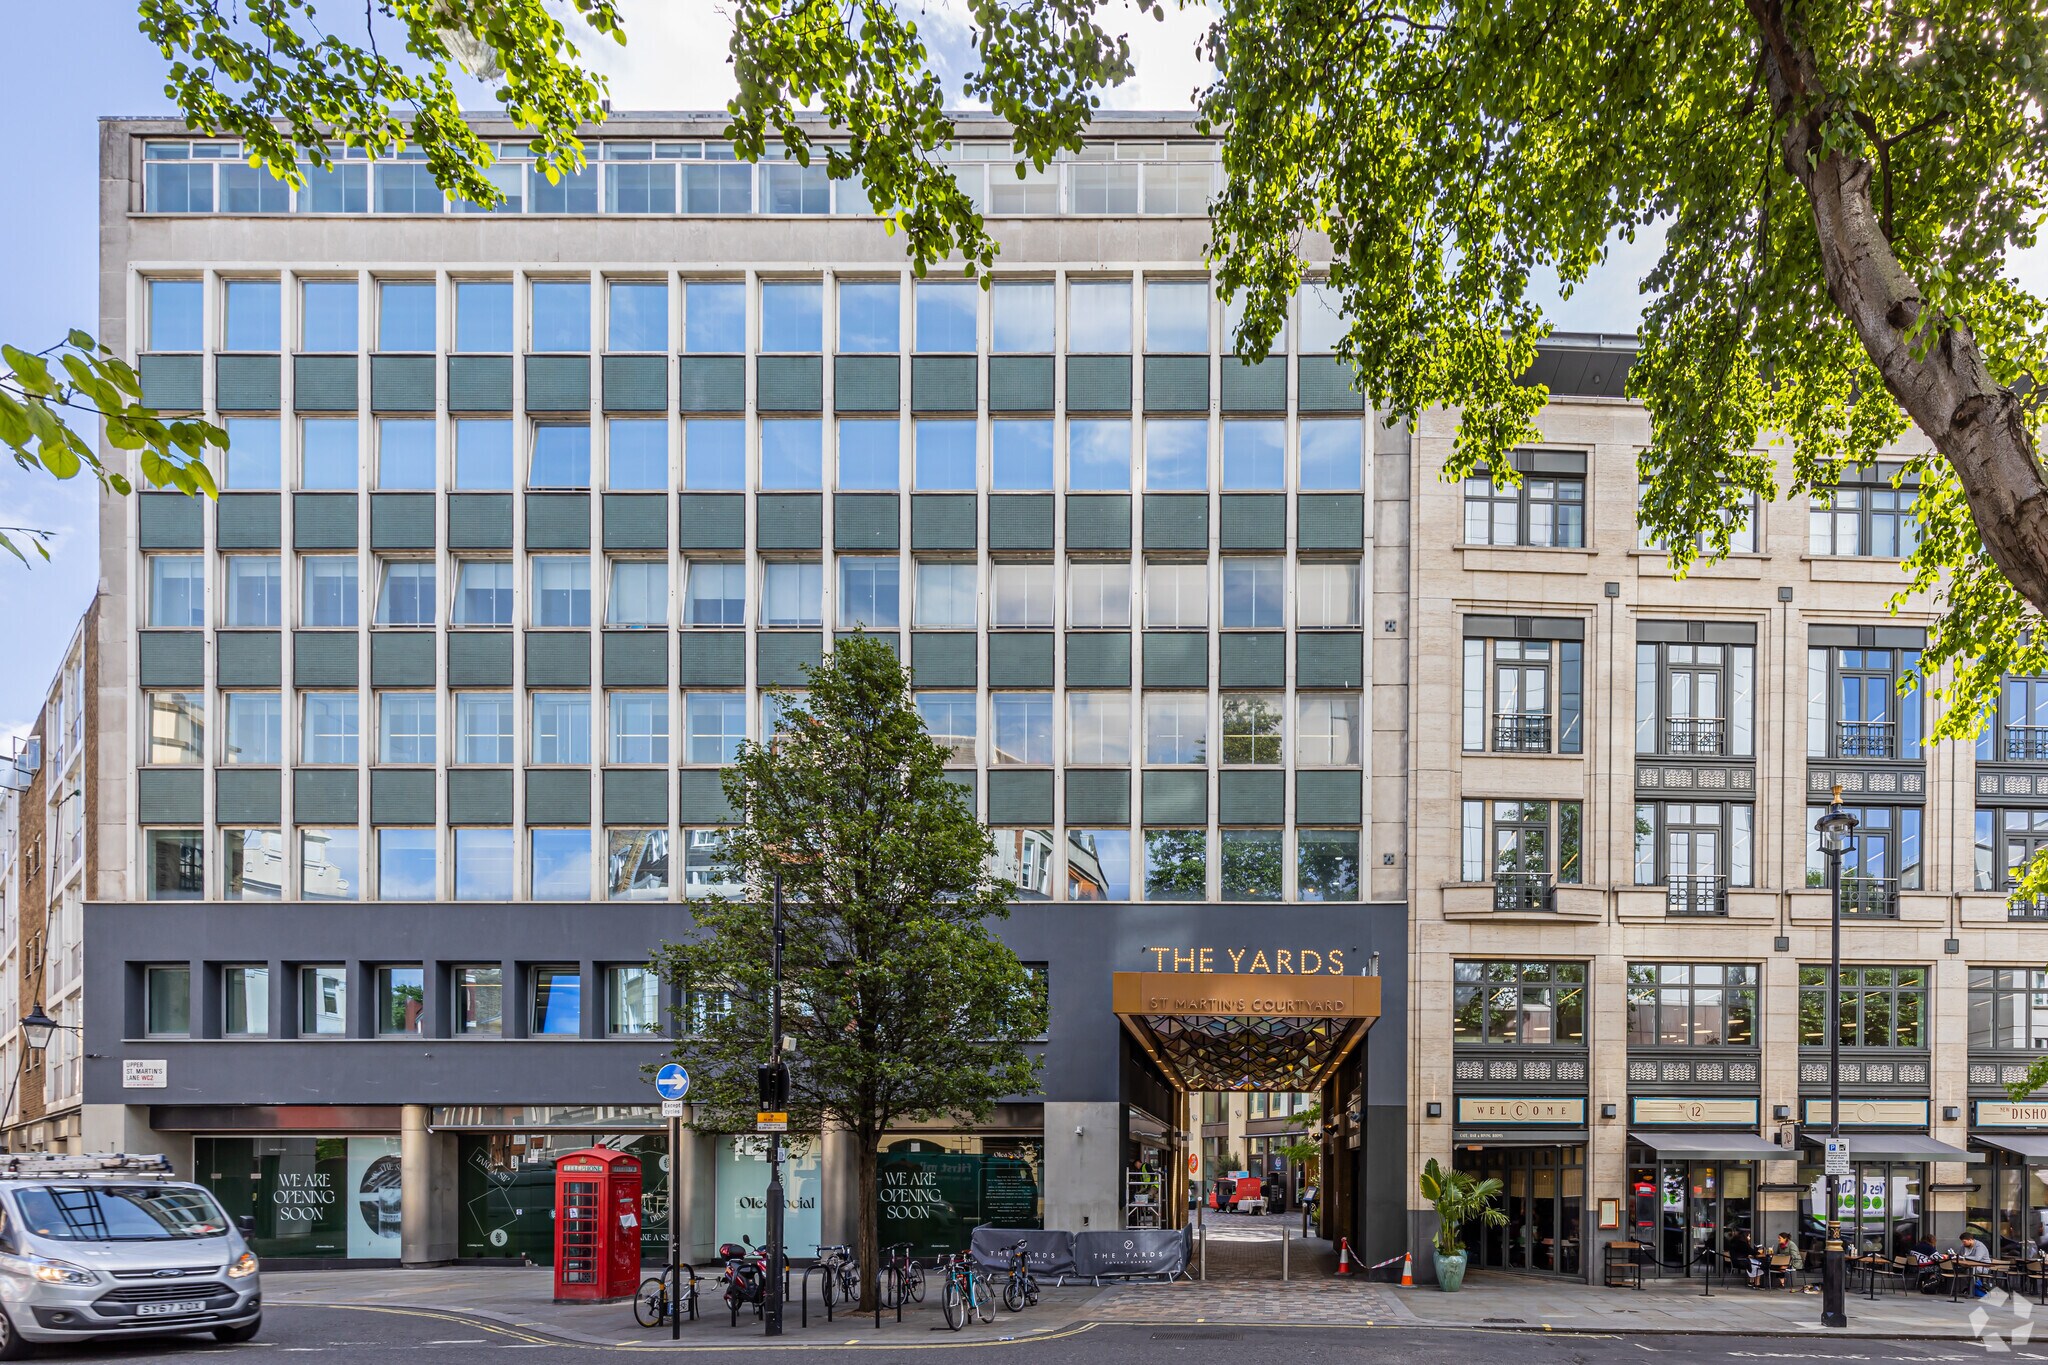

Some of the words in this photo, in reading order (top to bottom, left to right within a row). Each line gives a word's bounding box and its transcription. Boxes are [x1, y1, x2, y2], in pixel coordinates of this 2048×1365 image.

[1150, 947, 1213, 973] THE
[1227, 948, 1344, 975] YARDS
[1150, 998, 1168, 1009] ST
[1175, 998, 1245, 1012] MARTIN'S
[1252, 999, 1344, 1012] COURTYARD
[1477, 1105, 1566, 1116] WELCOME
[1692, 1107, 1701, 1117] 12
[476, 1154, 493, 1171] TAKE
[279, 1174, 301, 1187] WE
[304, 1174, 331, 1187] ARE
[885, 1172, 907, 1186] WE
[910, 1172, 937, 1186] ARE
[273, 1190, 335, 1204] OPENING
[880, 1189, 942, 1202] OPENING
[784, 1197, 815, 1209] ocial
[280, 1207, 324, 1220] SOON
[887, 1205, 930, 1219] SOON
[143, 1303, 175, 1313] SY67
